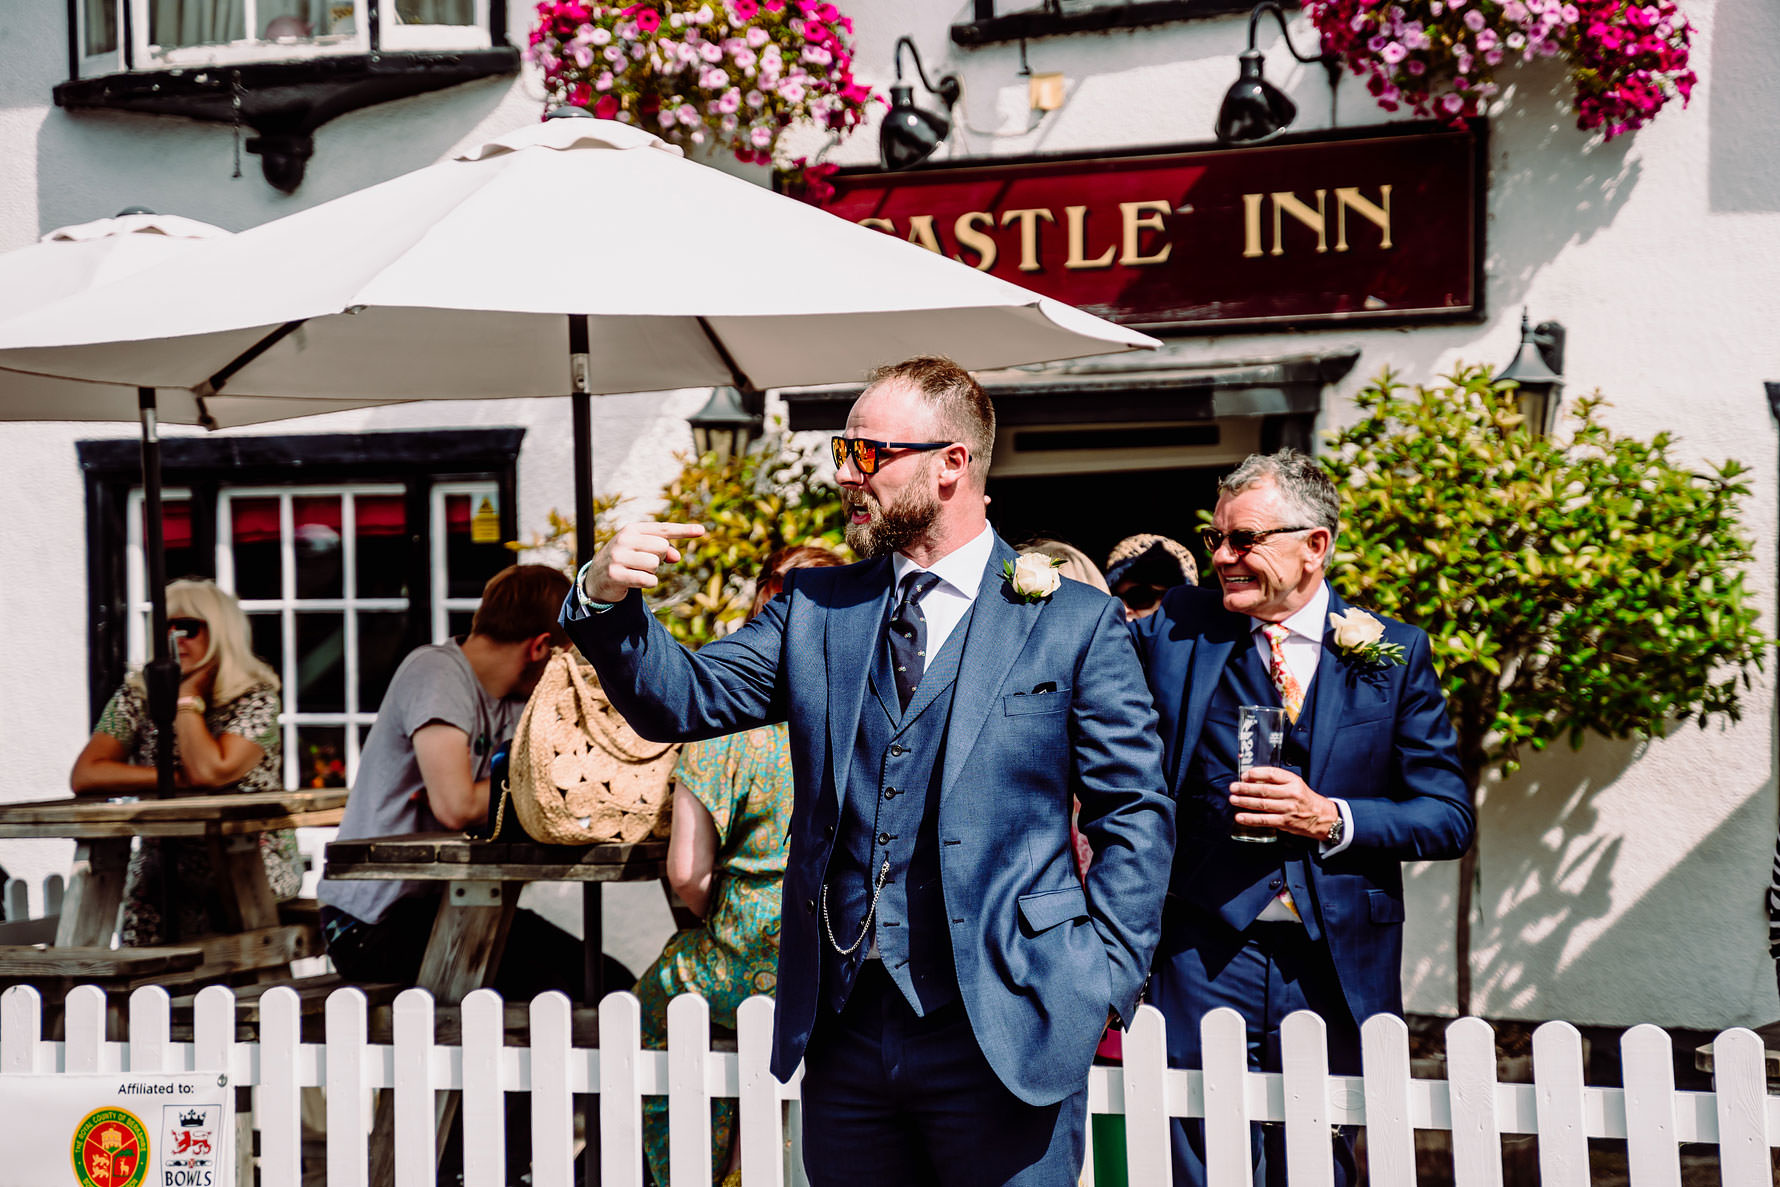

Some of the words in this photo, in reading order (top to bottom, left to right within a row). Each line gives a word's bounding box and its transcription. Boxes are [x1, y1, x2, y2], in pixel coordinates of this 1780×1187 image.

[857, 200, 1173, 272] ASTLE
[1242, 184, 1394, 258] INN
[118, 1083, 174, 1094] Affiliated
[178, 1084, 194, 1094] to:
[93, 1112, 116, 1123] COUNTY
[118, 1113, 126, 1121] OF
[165, 1171, 212, 1187] BOWLS
